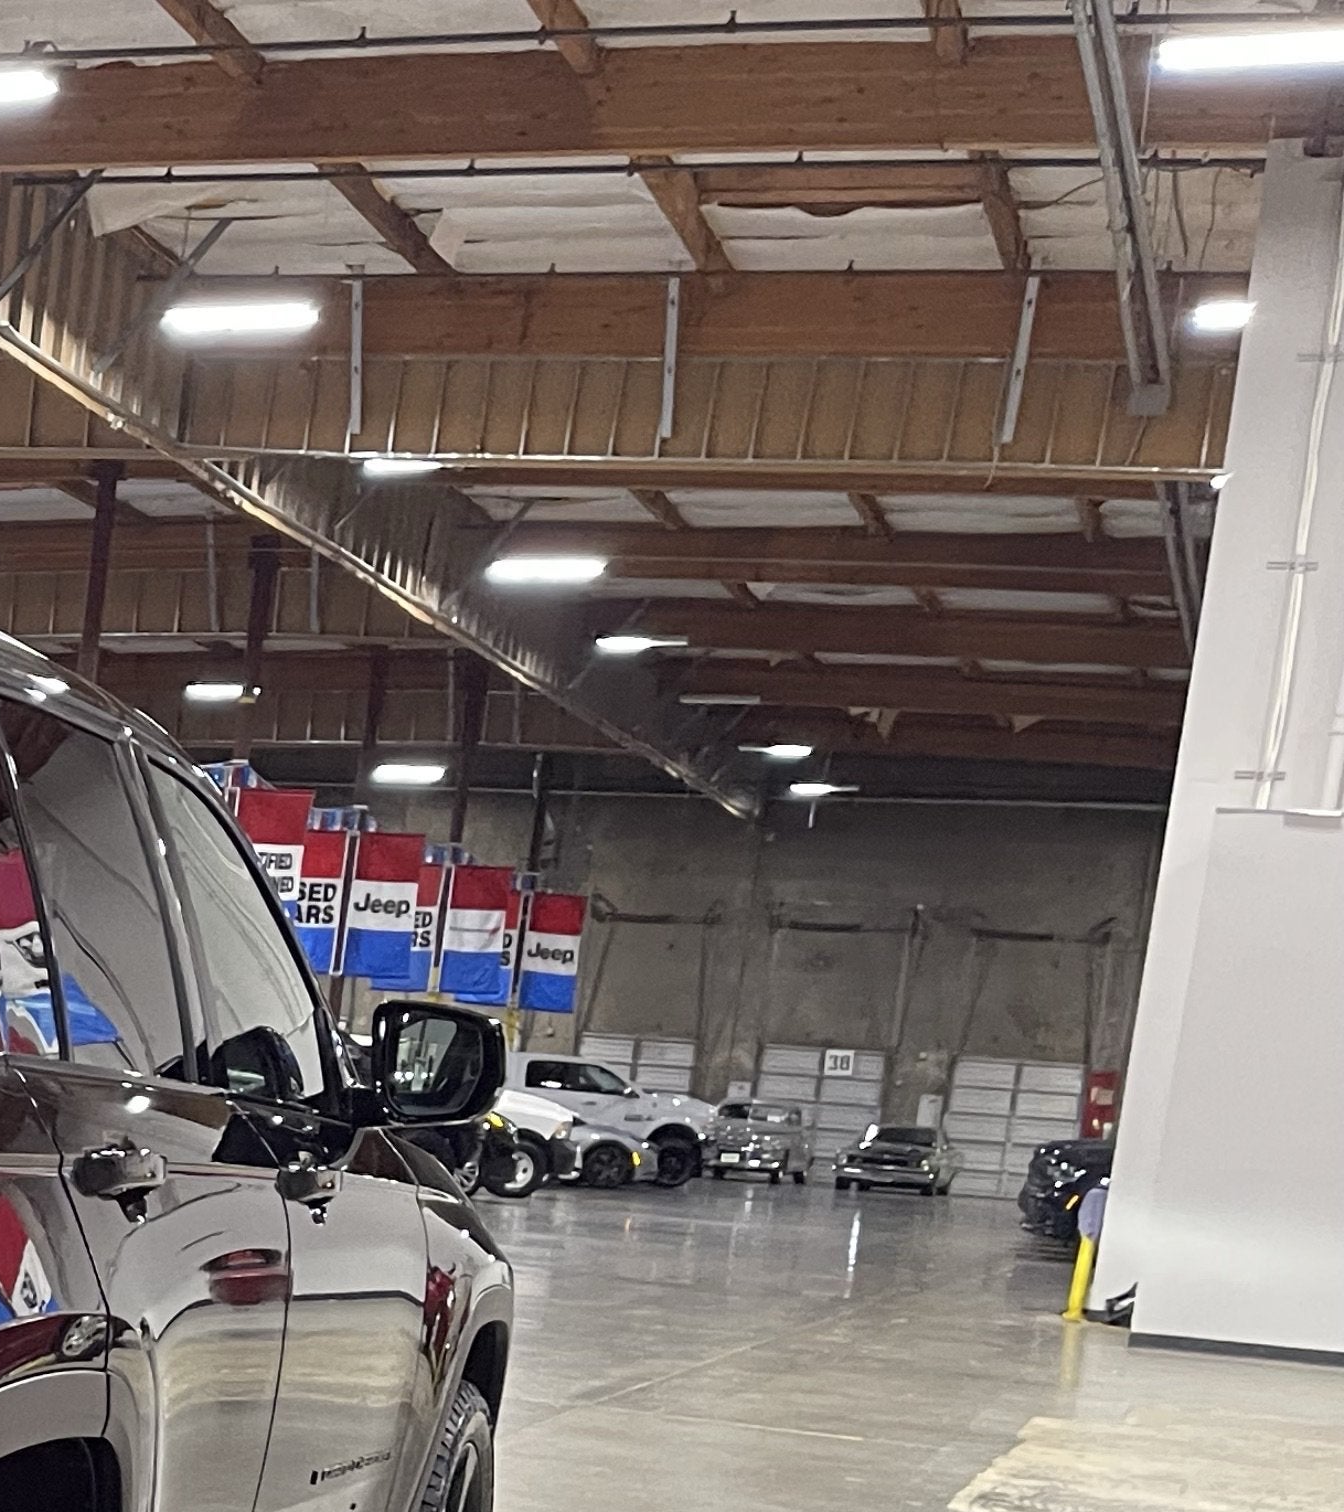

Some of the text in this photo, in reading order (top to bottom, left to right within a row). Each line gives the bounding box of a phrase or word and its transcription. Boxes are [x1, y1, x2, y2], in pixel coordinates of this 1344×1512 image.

[296, 882, 337, 902] SED
[353, 892, 411, 918] Jeep
[527, 942, 575, 965] Jeep
